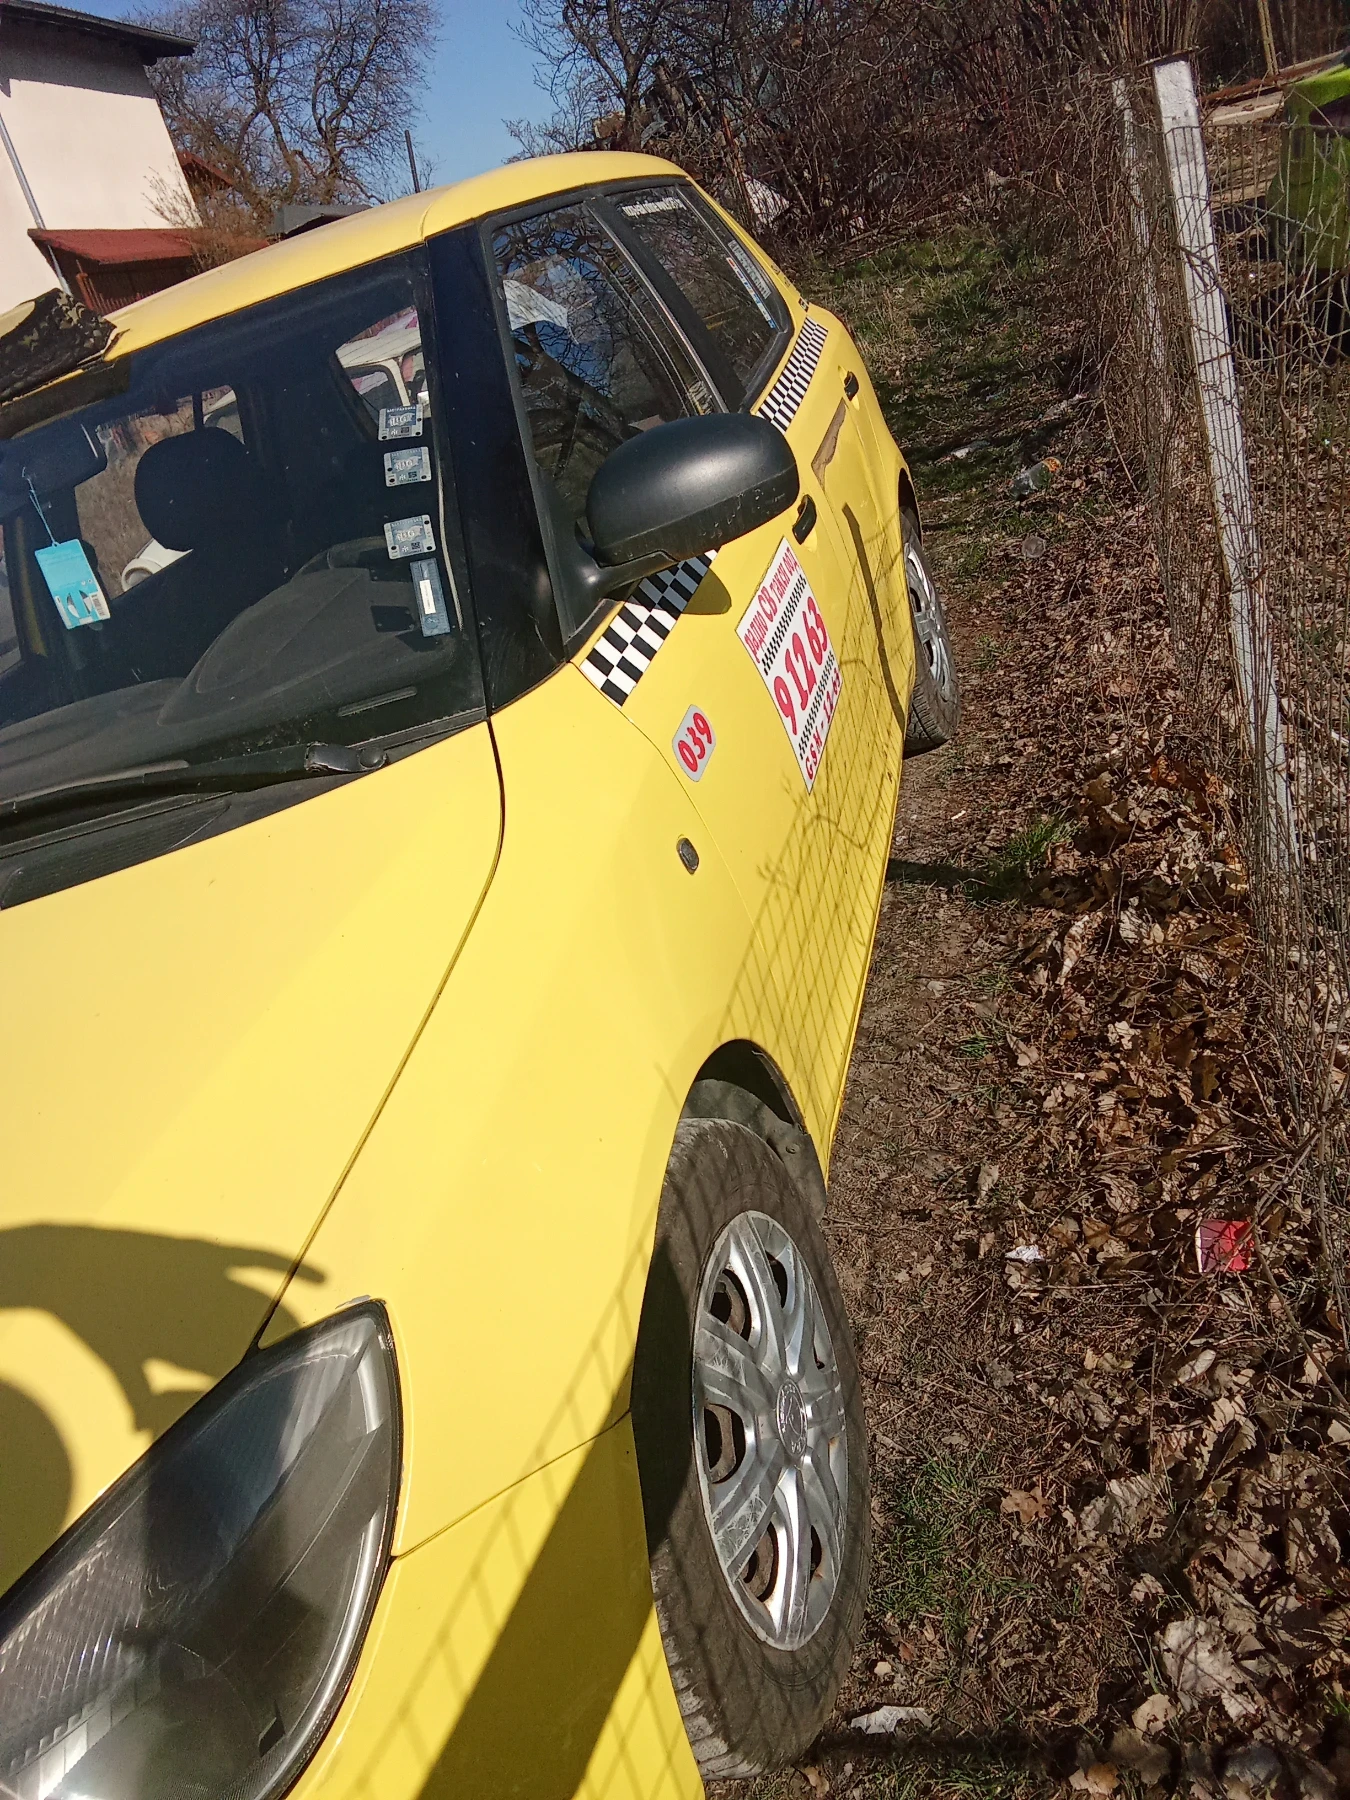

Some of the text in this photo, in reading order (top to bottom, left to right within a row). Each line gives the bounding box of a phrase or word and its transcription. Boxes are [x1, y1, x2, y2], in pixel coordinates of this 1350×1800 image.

[744, 610, 769, 664] радио
[769, 562, 791, 604] такси
[678, 712, 713, 773] 039
[805, 725, 823, 780] GSM
